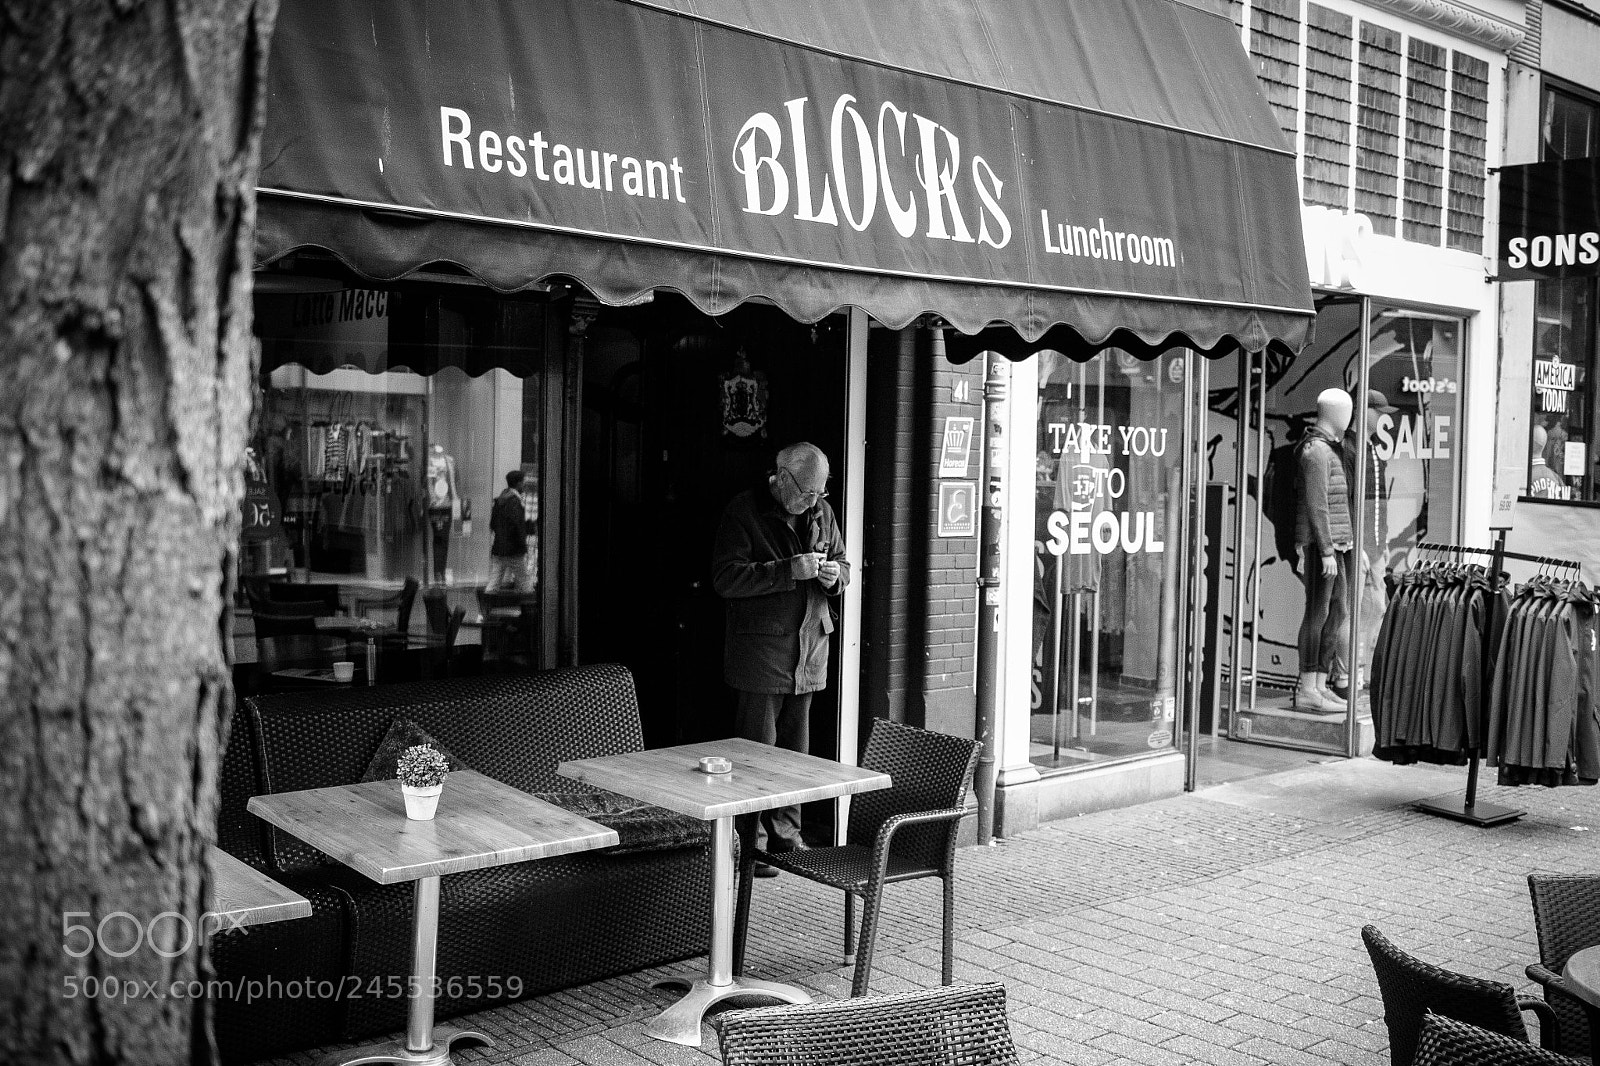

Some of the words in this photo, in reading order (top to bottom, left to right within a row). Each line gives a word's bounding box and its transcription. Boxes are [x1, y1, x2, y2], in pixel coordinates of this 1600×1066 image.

[440, 105, 686, 203] Restaurant
[732, 93, 1012, 249] BLOCKS
[1040, 209, 1177, 267] Lunchroom
[1507, 232, 1600, 269] SONS
[1536, 362, 1574, 388] AMERICA
[1542, 388, 1567, 413] TODAY
[1048, 423, 1112, 455] TAKE
[1118, 425, 1168, 457] YOU
[1374, 413, 1451, 461] SALE
[1092, 467, 1126, 499] TO
[1046, 511, 1165, 556] SEOUL
